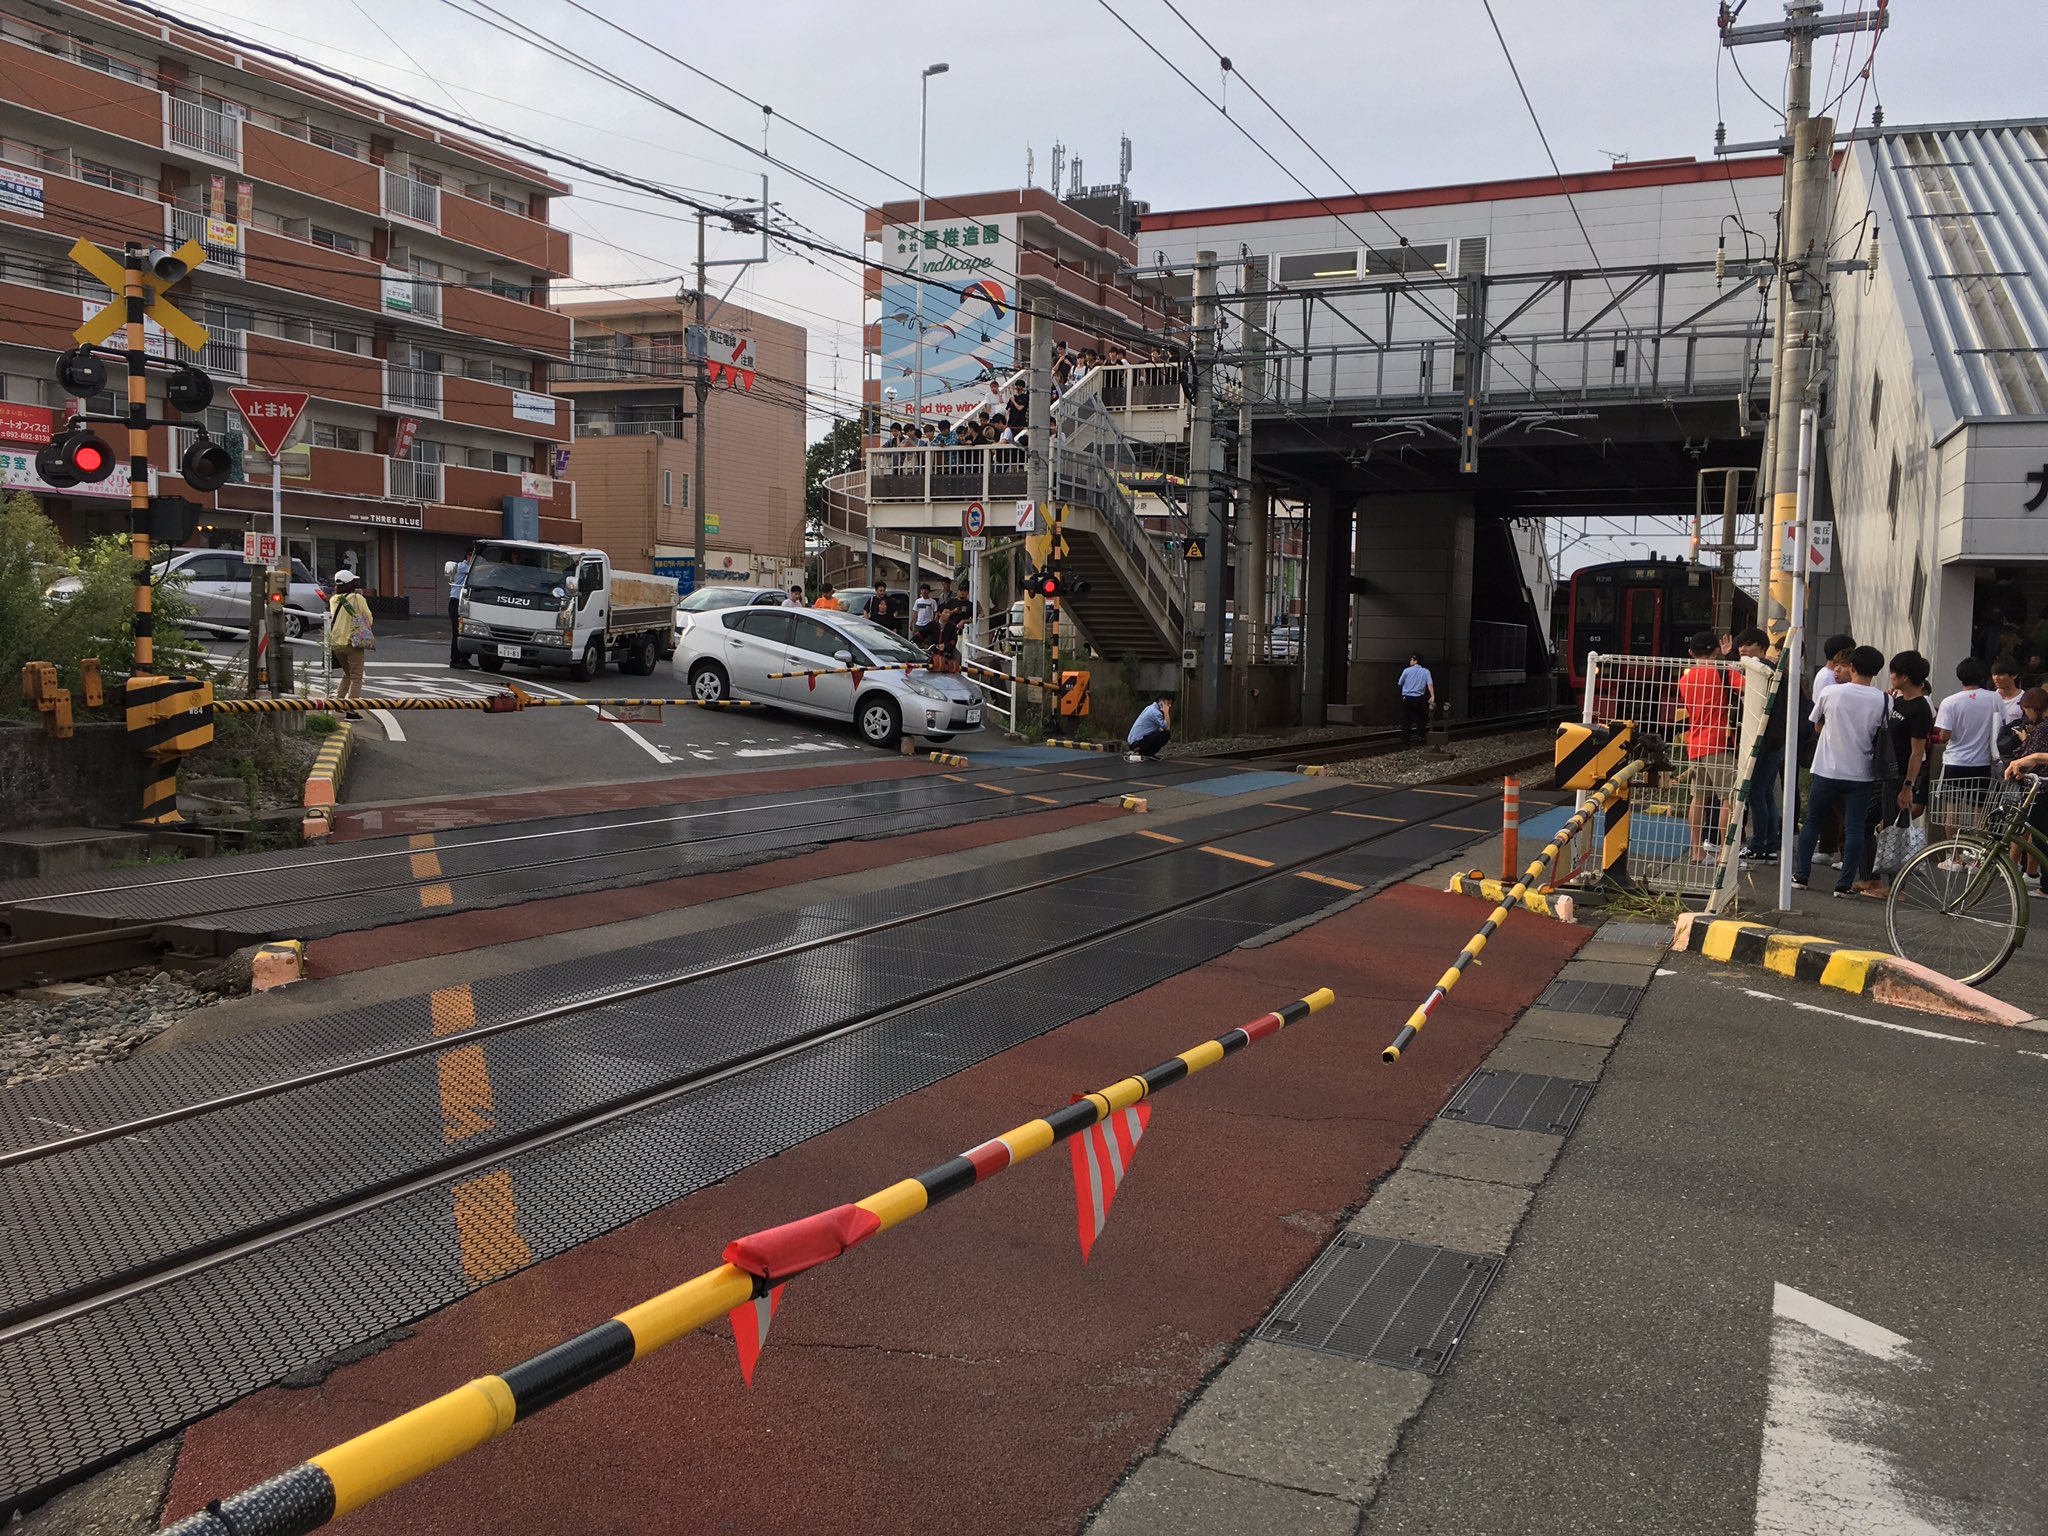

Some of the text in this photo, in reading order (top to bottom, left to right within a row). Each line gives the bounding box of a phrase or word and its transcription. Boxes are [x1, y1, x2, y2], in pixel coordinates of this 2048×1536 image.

[924, 224, 999, 250] 香椎造園
[903, 253, 994, 275] Lndscape
[248, 401, 294, 418] 止まれ
[905, 403, 932, 414] Rad
[935, 402, 952, 413] the
[370, 515, 397, 524] THREE
[399, 517, 420, 526] BLUE
[1191, 546, 1199, 556] 2
[496, 595, 531, 607] ISUZU
